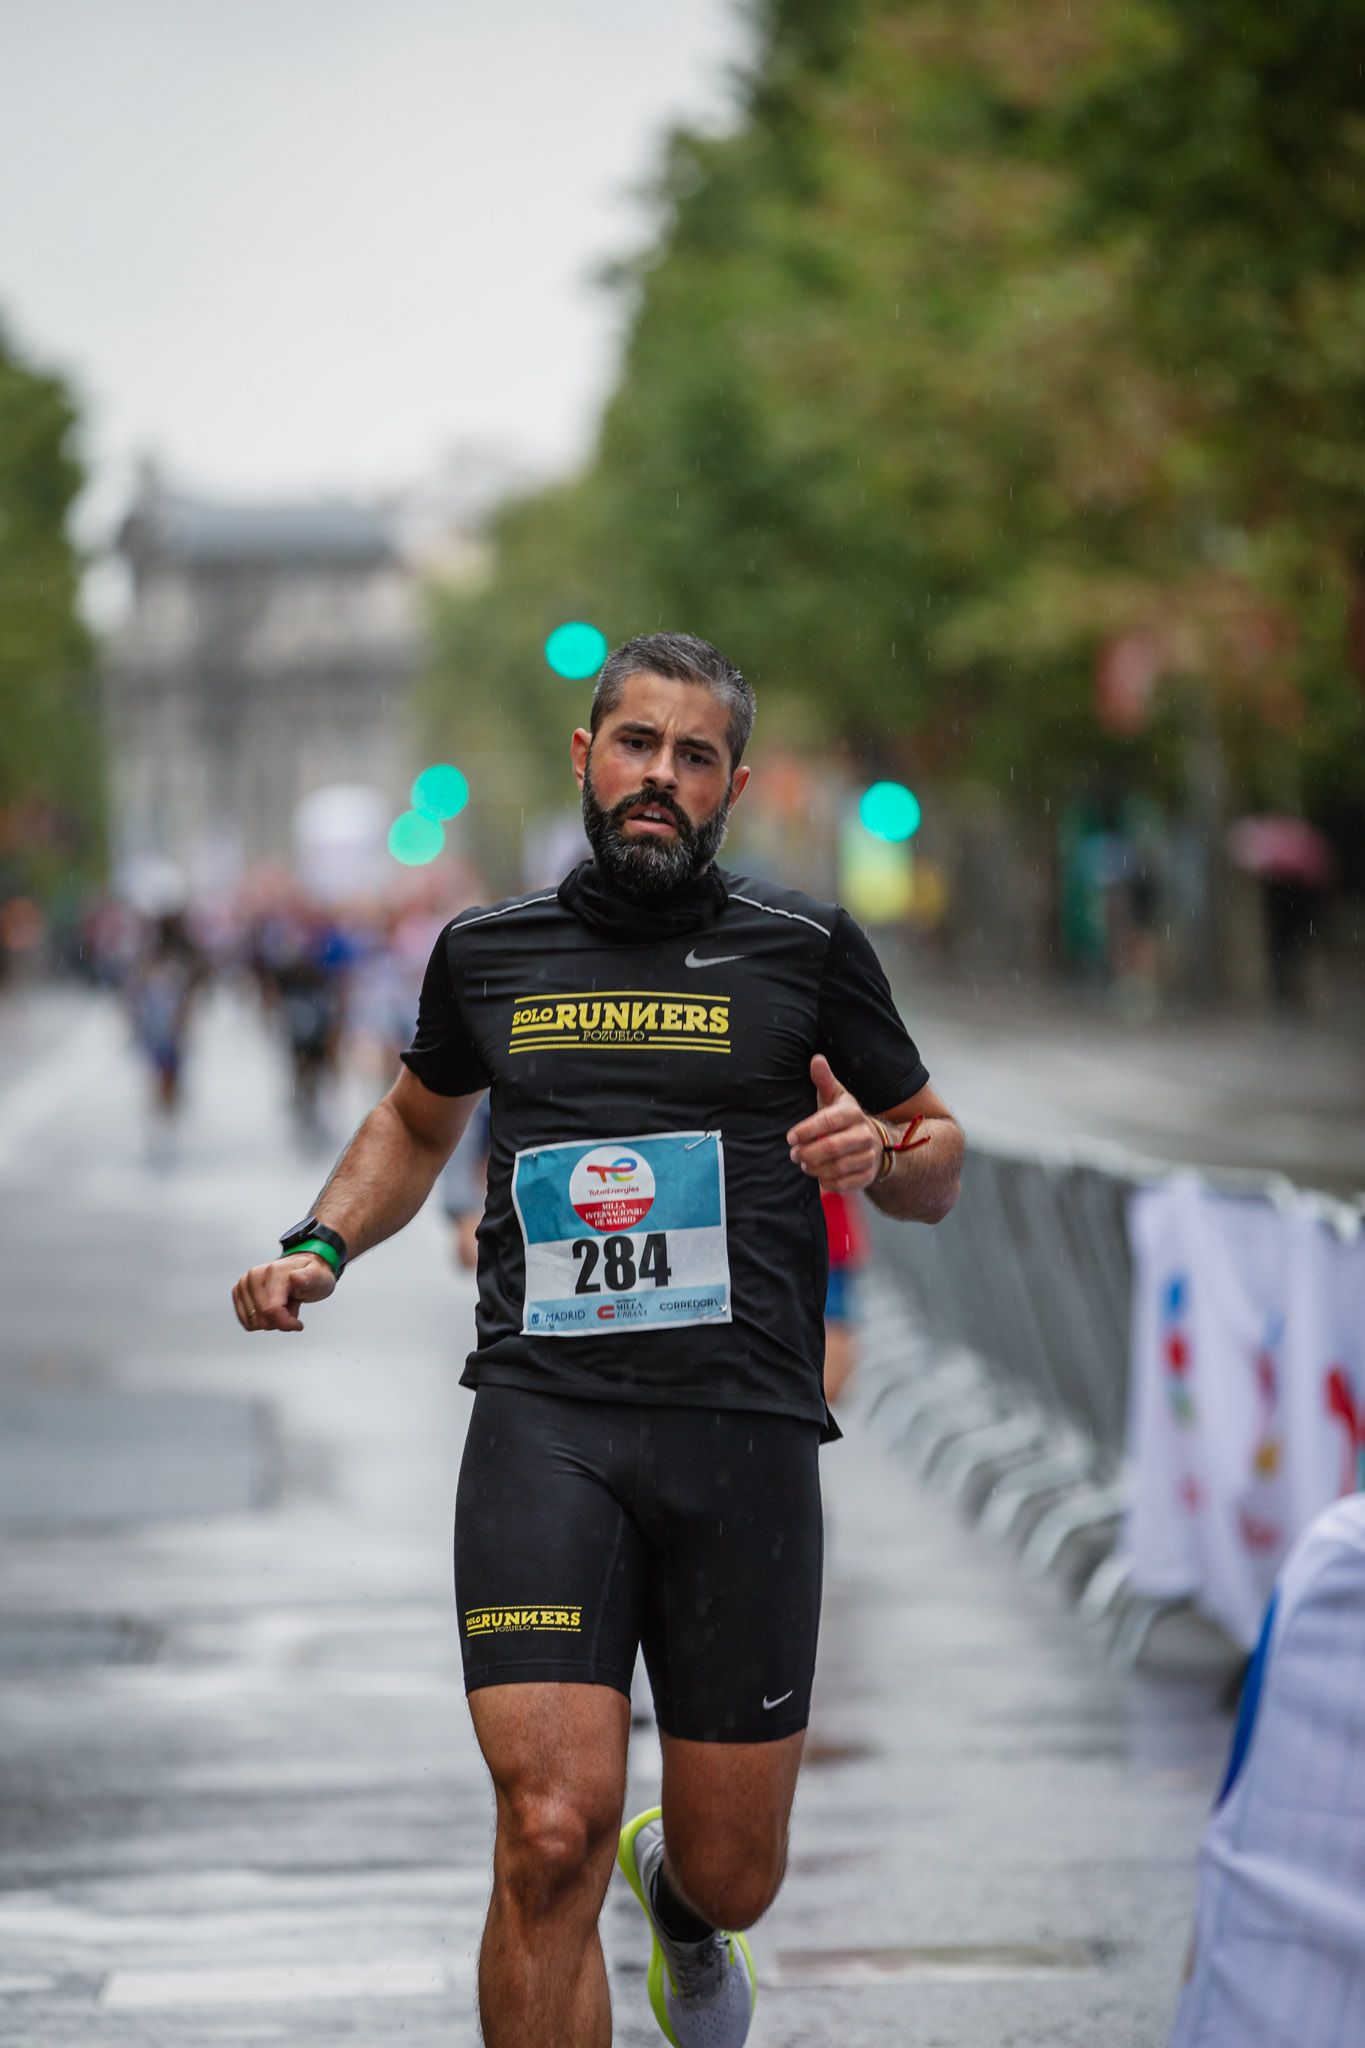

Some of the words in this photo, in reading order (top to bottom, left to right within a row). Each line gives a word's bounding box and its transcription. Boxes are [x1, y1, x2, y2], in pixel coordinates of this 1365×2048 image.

[512, 1007, 554, 1026] SOLO
[583, 1030, 645, 1042] POZUELO
[588, 1186, 640, 1197] TotalEnergies
[602, 1201, 626, 1210] MILLA
[594, 1219, 605, 1227] DE
[605, 1216, 636, 1226] MADRID
[572, 1232, 672, 1295] 284
[616, 1302, 643, 1311] MILLA
[545, 1308, 586, 1323] MADRID
[617, 1309, 648, 1319] URBANA
[466, 1615, 481, 1627] SOLO
[495, 1624, 531, 1633] POZUELO
